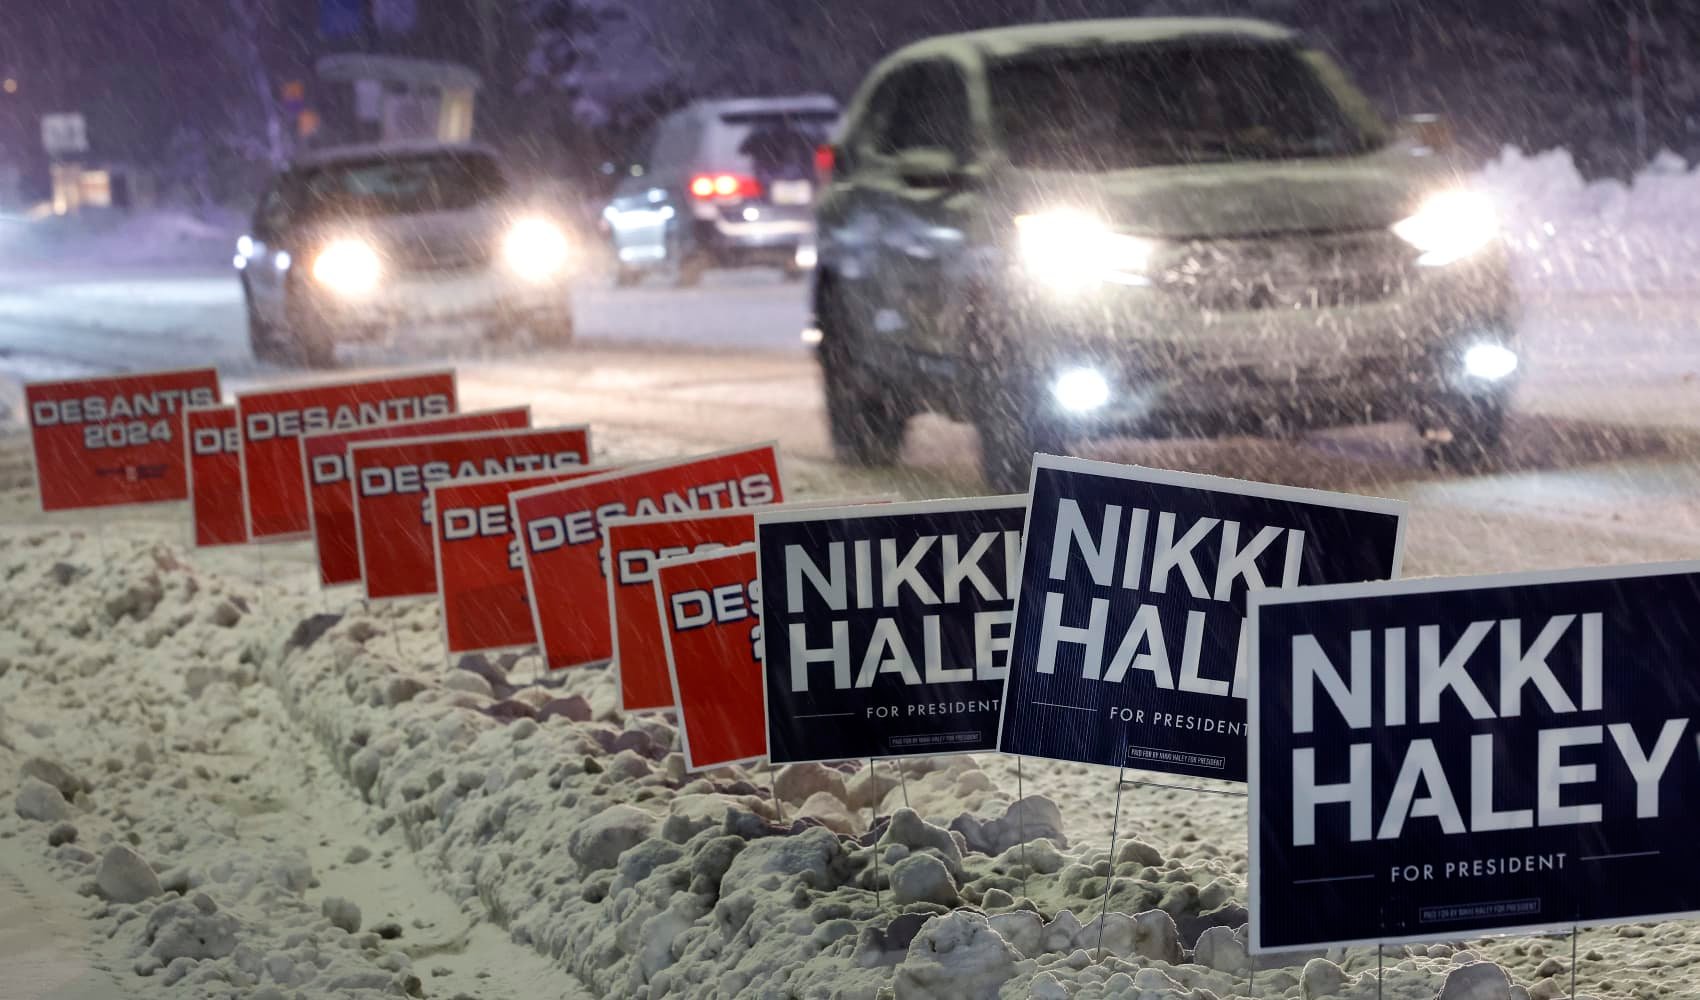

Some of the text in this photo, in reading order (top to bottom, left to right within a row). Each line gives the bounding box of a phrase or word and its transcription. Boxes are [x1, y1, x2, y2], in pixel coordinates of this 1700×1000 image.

[34, 387, 213, 426] DESANTIS
[246, 394, 449, 441] DESANTIS
[84, 419, 172, 449] 2024
[1049, 497, 1306, 602] NIKKI
[785, 530, 1024, 613] NIKKI
[1292, 612, 1603, 734] NIKKI
[866, 699, 999, 718] FOR PRESIDENT
[1110, 706, 1248, 737] FOR PRESIDENT
[1292, 718, 1690, 847] HALEY
[1391, 853, 1567, 883] FOR PRESIDENT
